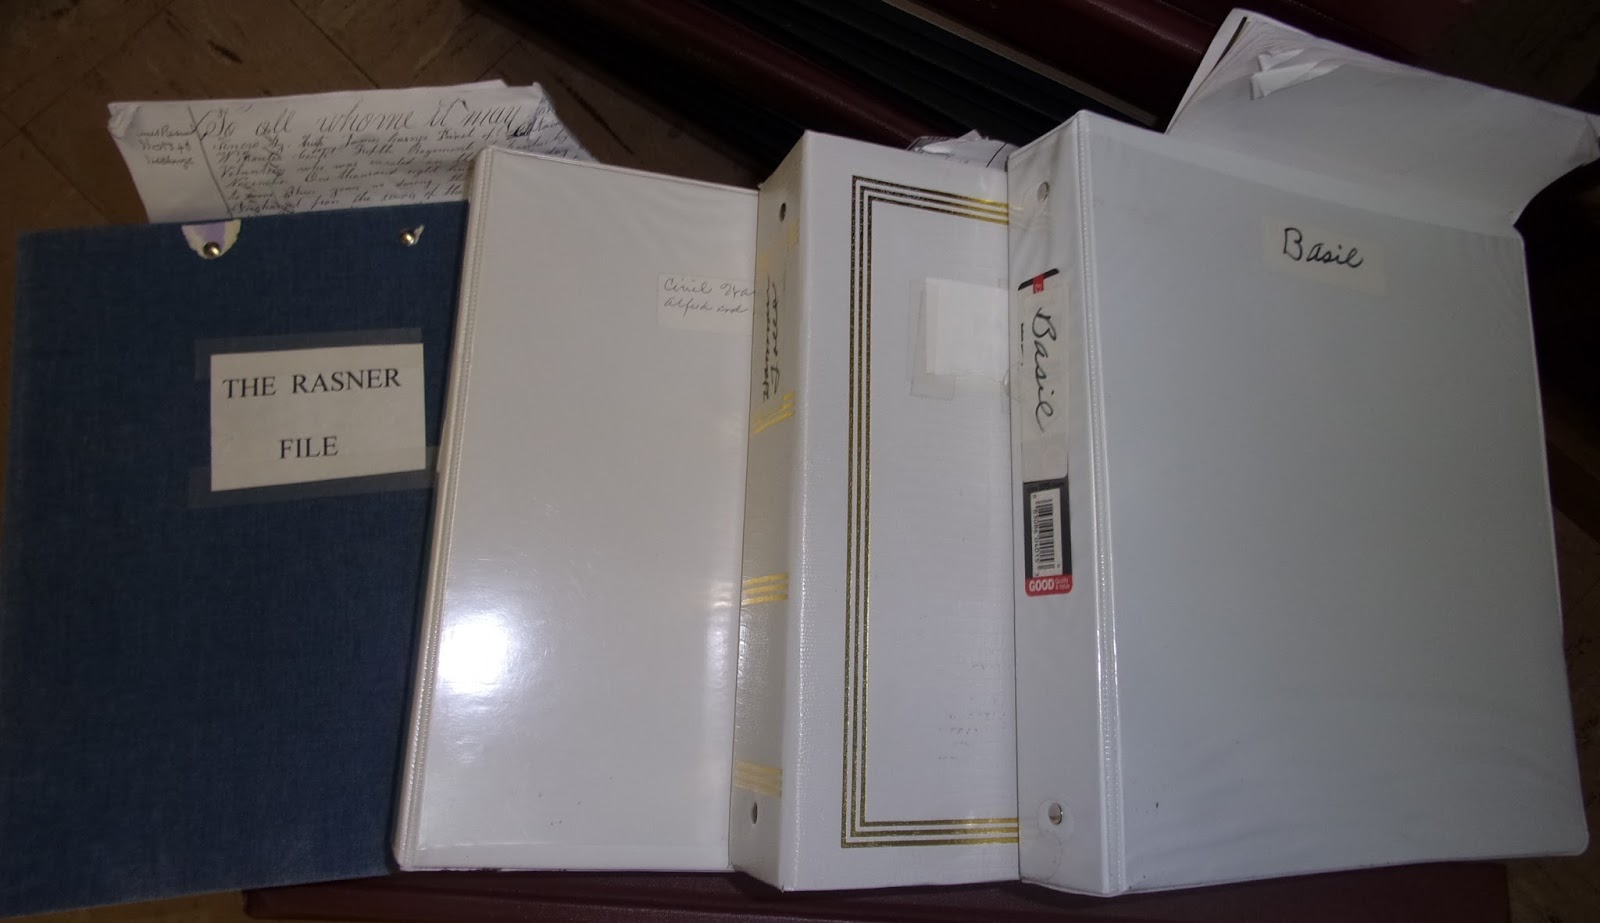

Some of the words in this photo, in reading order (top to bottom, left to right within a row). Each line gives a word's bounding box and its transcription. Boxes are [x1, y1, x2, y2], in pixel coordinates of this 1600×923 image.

[255, 108, 297, 136] all
[222, 376, 277, 399] THE
[291, 367, 402, 395] RASNER
[279, 435, 339, 460] FILE
[1029, 578, 1055, 592] GOOD
